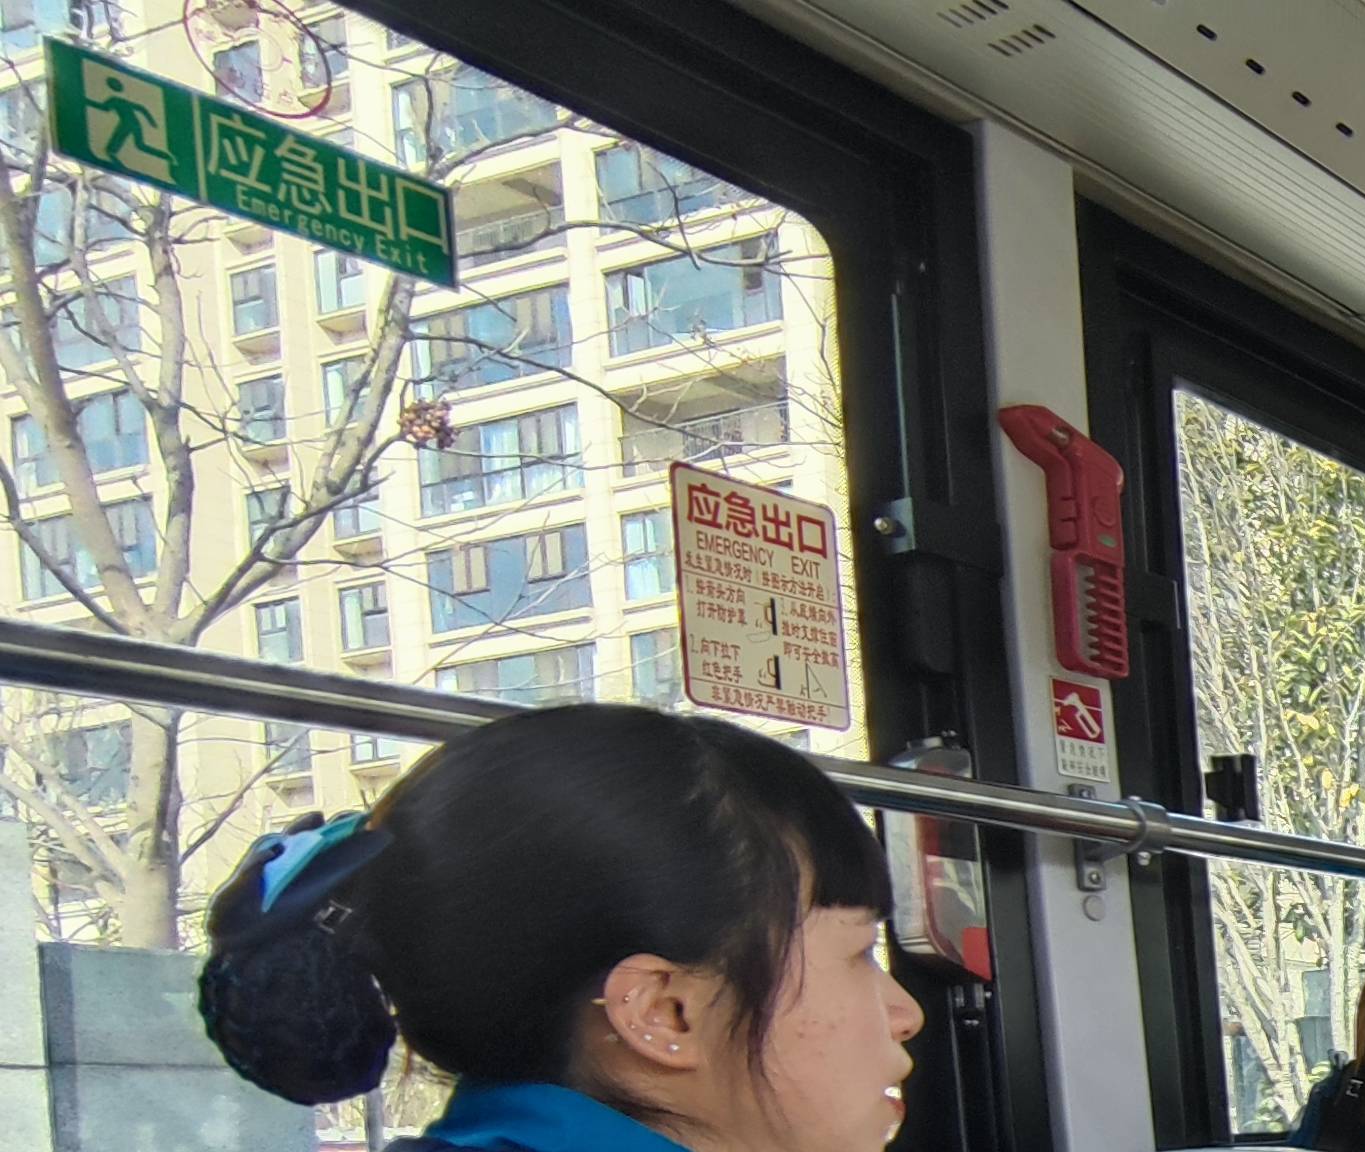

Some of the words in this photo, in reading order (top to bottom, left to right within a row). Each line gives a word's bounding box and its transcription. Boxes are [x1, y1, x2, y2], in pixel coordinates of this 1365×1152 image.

[208, 112, 449, 256] 应急出口
[235, 184, 366, 250] Emergency
[375, 236, 428, 274] Exit
[687, 483, 828, 559] 应急出口
[696, 530, 774, 569] EMERGENCY
[791, 555, 821, 581] EXIT
